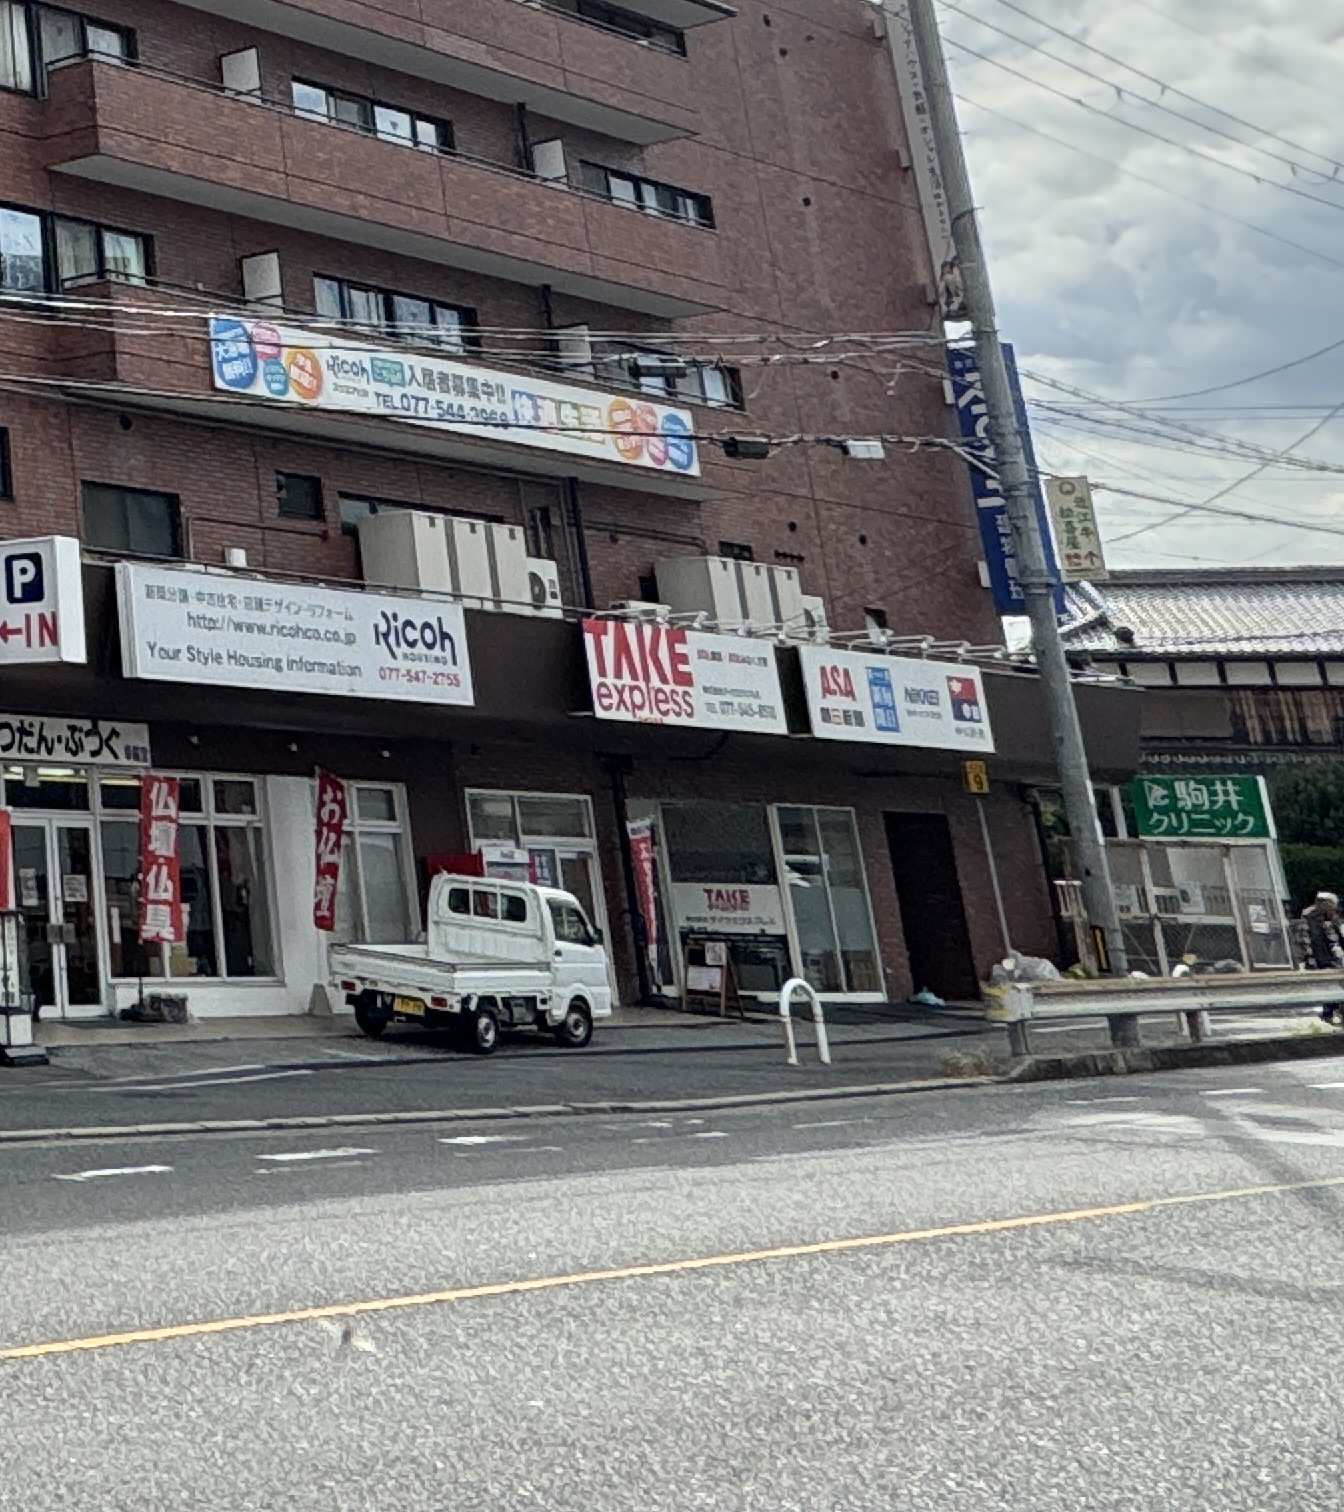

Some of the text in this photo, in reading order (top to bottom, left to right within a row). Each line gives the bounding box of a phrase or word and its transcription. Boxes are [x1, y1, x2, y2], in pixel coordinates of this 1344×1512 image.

[12, 559, 36, 599] P
[24, 610, 59, 648] IN
[373, 610, 458, 666] Ricoh
[146, 640, 182, 661] Your
[186, 644, 223, 666] Style
[227, 650, 283, 673] Housing
[582, 618, 694, 688] TAKE
[596, 680, 695, 719] express
[820, 664, 858, 702] ASA
[1173, 779, 1244, 811] 駒井
[1148, 811, 1256, 835] クリニック
